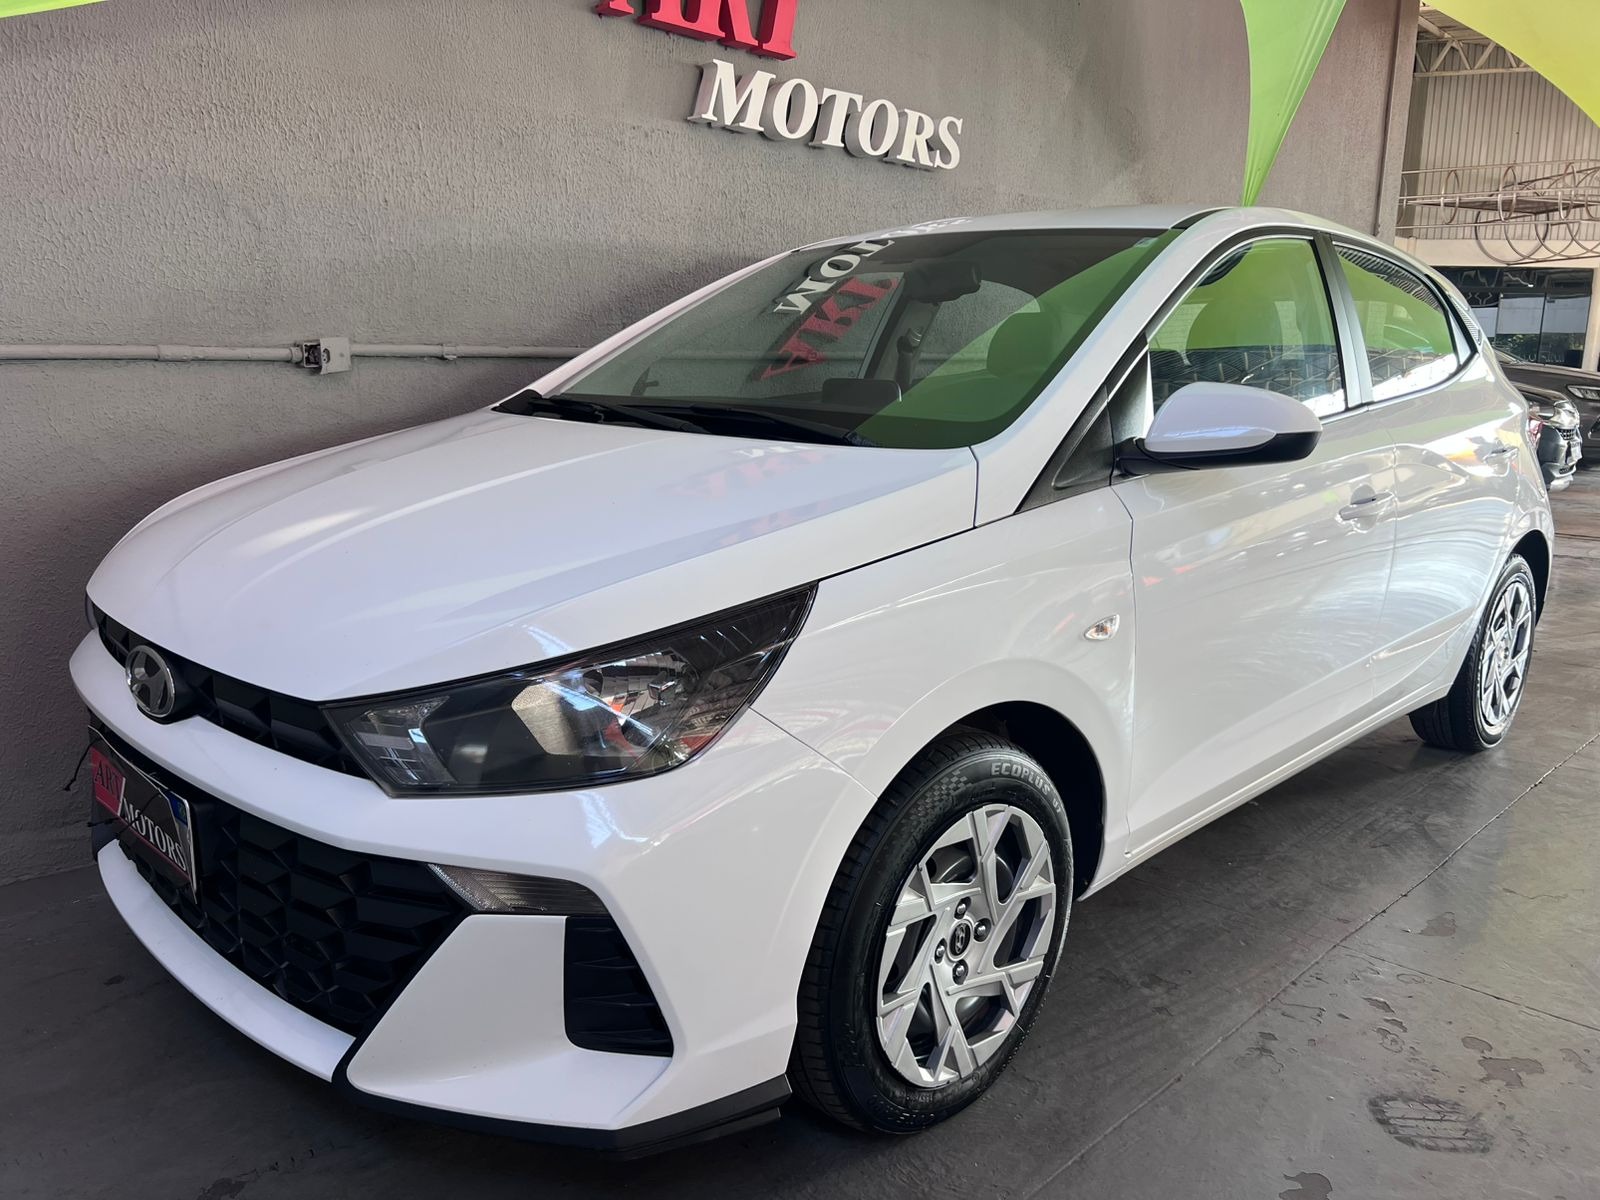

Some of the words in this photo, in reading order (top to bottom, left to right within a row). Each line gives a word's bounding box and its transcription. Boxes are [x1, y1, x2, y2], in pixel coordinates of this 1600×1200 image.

[690, 59, 963, 171] MOTORS
[991, 762, 1050, 795] ECOPLUS
[121, 797, 187, 871] MOTORS
